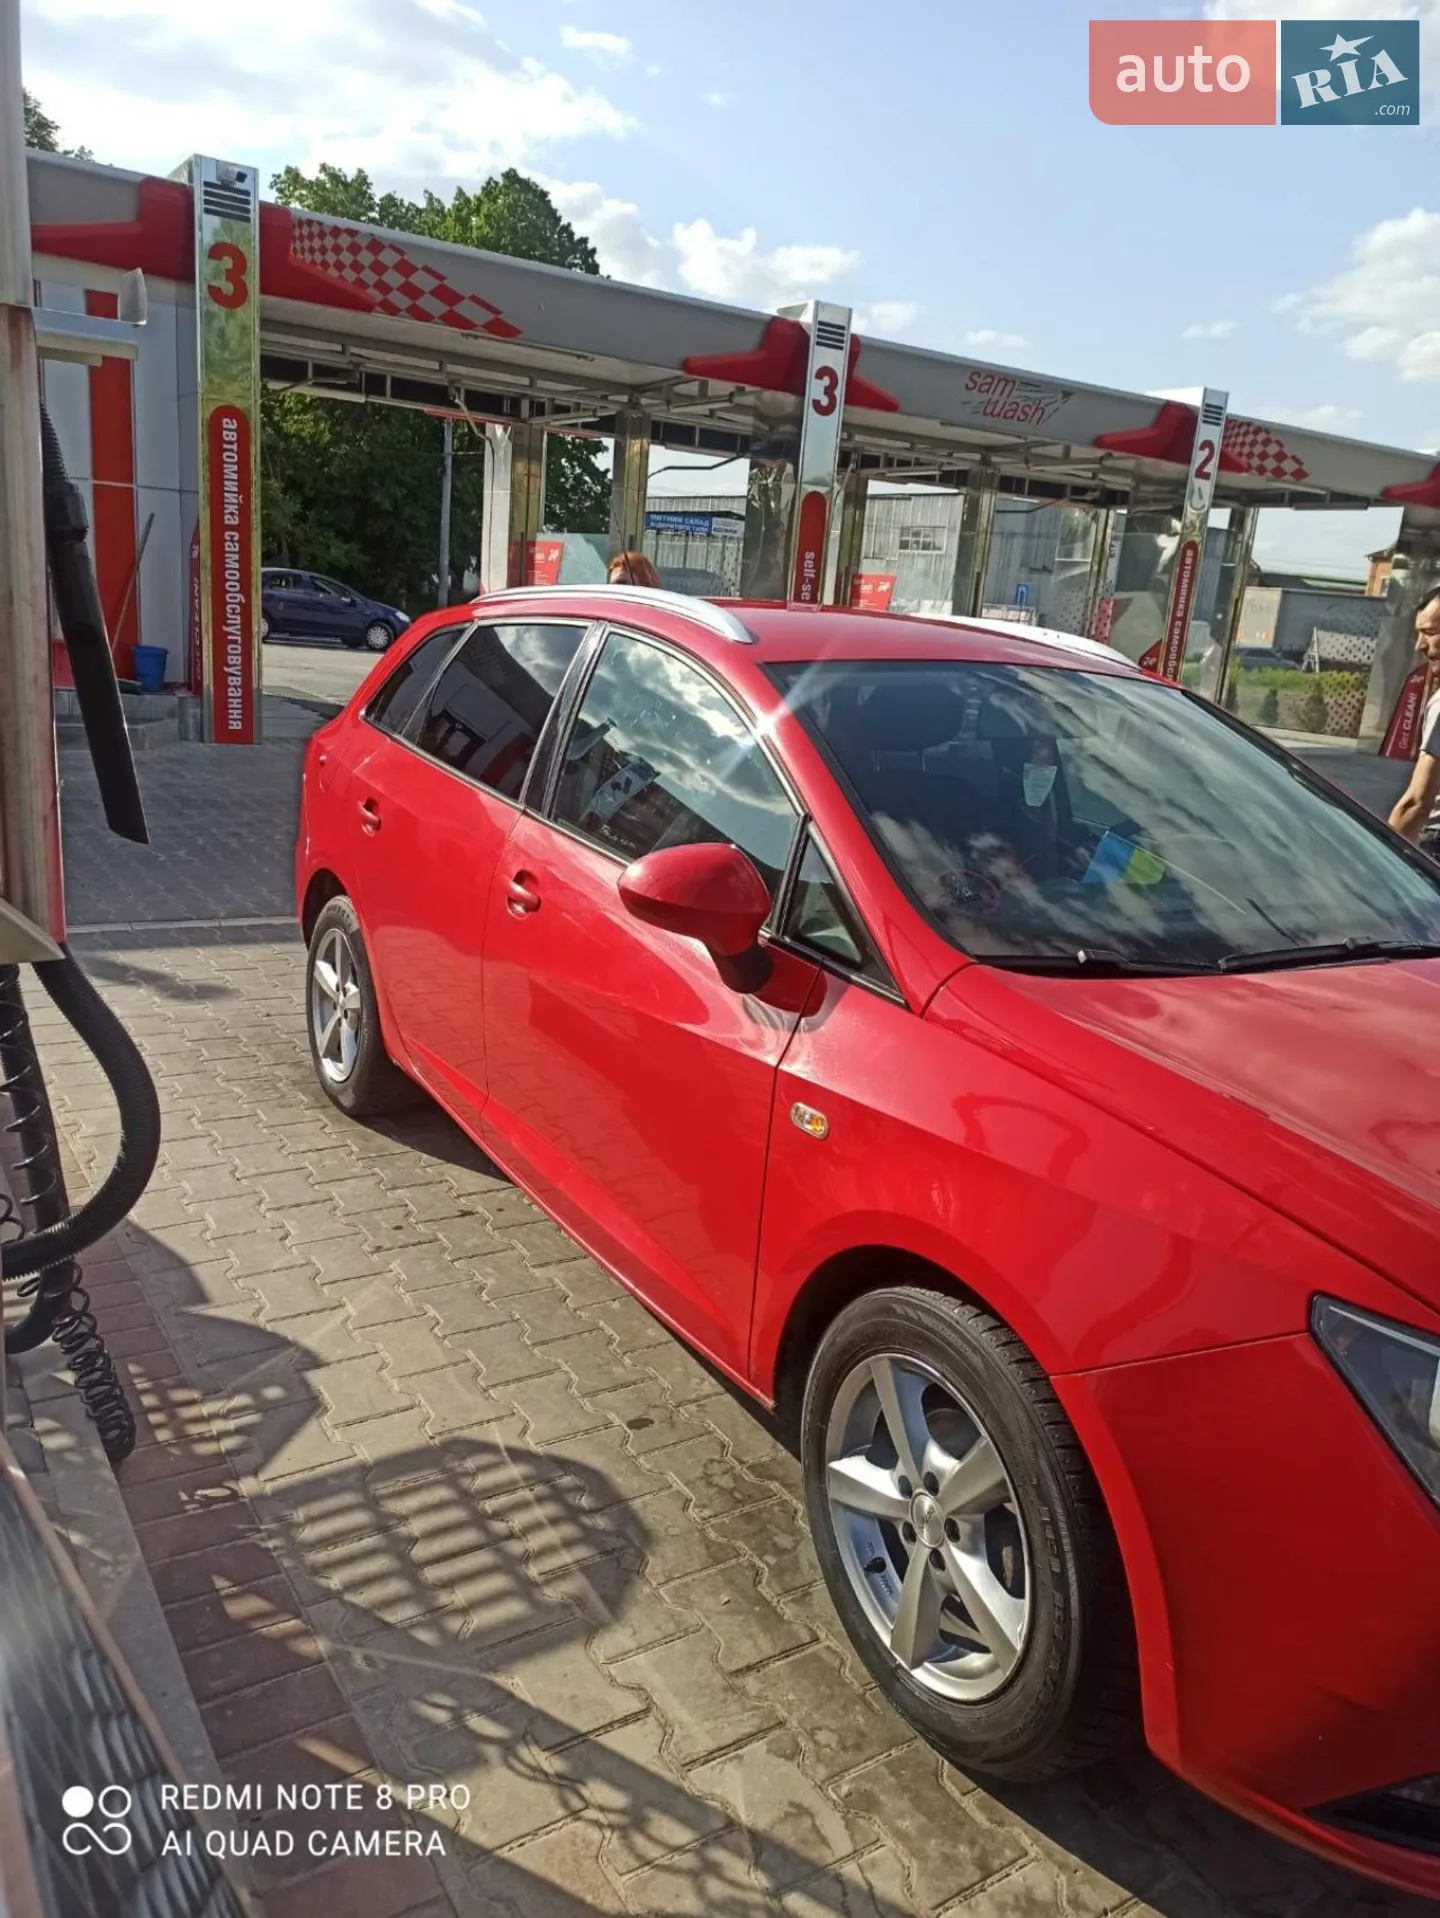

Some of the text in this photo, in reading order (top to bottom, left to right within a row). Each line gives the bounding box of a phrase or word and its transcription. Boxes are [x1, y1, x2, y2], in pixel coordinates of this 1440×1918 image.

[207, 241, 249, 309] 3
[812, 365, 839, 416] 3
[965, 371, 1017, 398] sam
[982, 398, 1045, 425] wash
[1194, 439, 1216, 481] 2
[221, 417, 245, 730] автомийка самообслуговування
